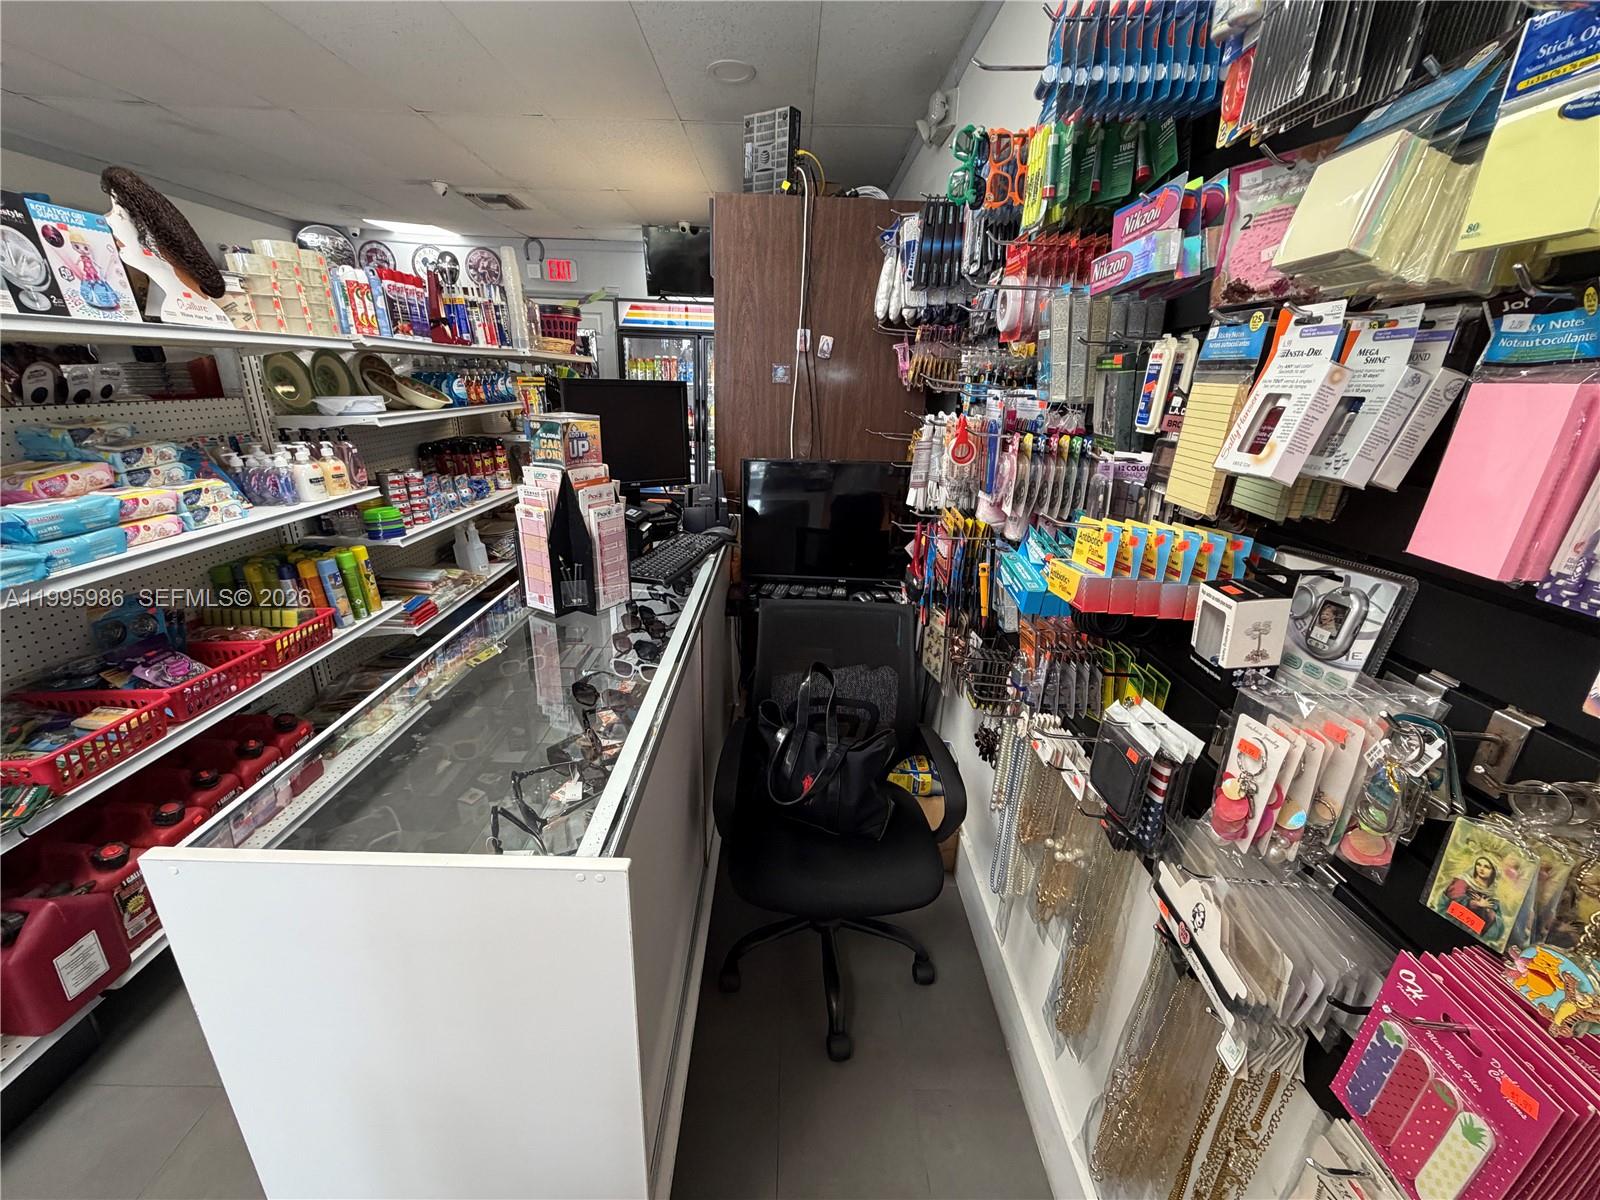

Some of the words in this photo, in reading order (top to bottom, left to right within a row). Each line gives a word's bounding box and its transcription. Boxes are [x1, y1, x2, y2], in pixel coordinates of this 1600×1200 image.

[1537, 34, 1576, 58] Stick
[1120, 142, 1136, 153] TUBE
[1121, 208, 1161, 238] Nikzon
[1240, 213, 1254, 231] 2
[1466, 223, 1480, 233] 80
[547, 259, 571, 281] EXIT
[1091, 256, 1127, 282] Nikzon
[1549, 317, 1585, 330] Notes
[1357, 348, 1379, 357] MEGA
[1364, 356, 1387, 365] SHINE
[1220, 430, 1242, 461] Sally
[1236, 391, 1261, 433] Hansen
[569, 440, 590, 458] UP
